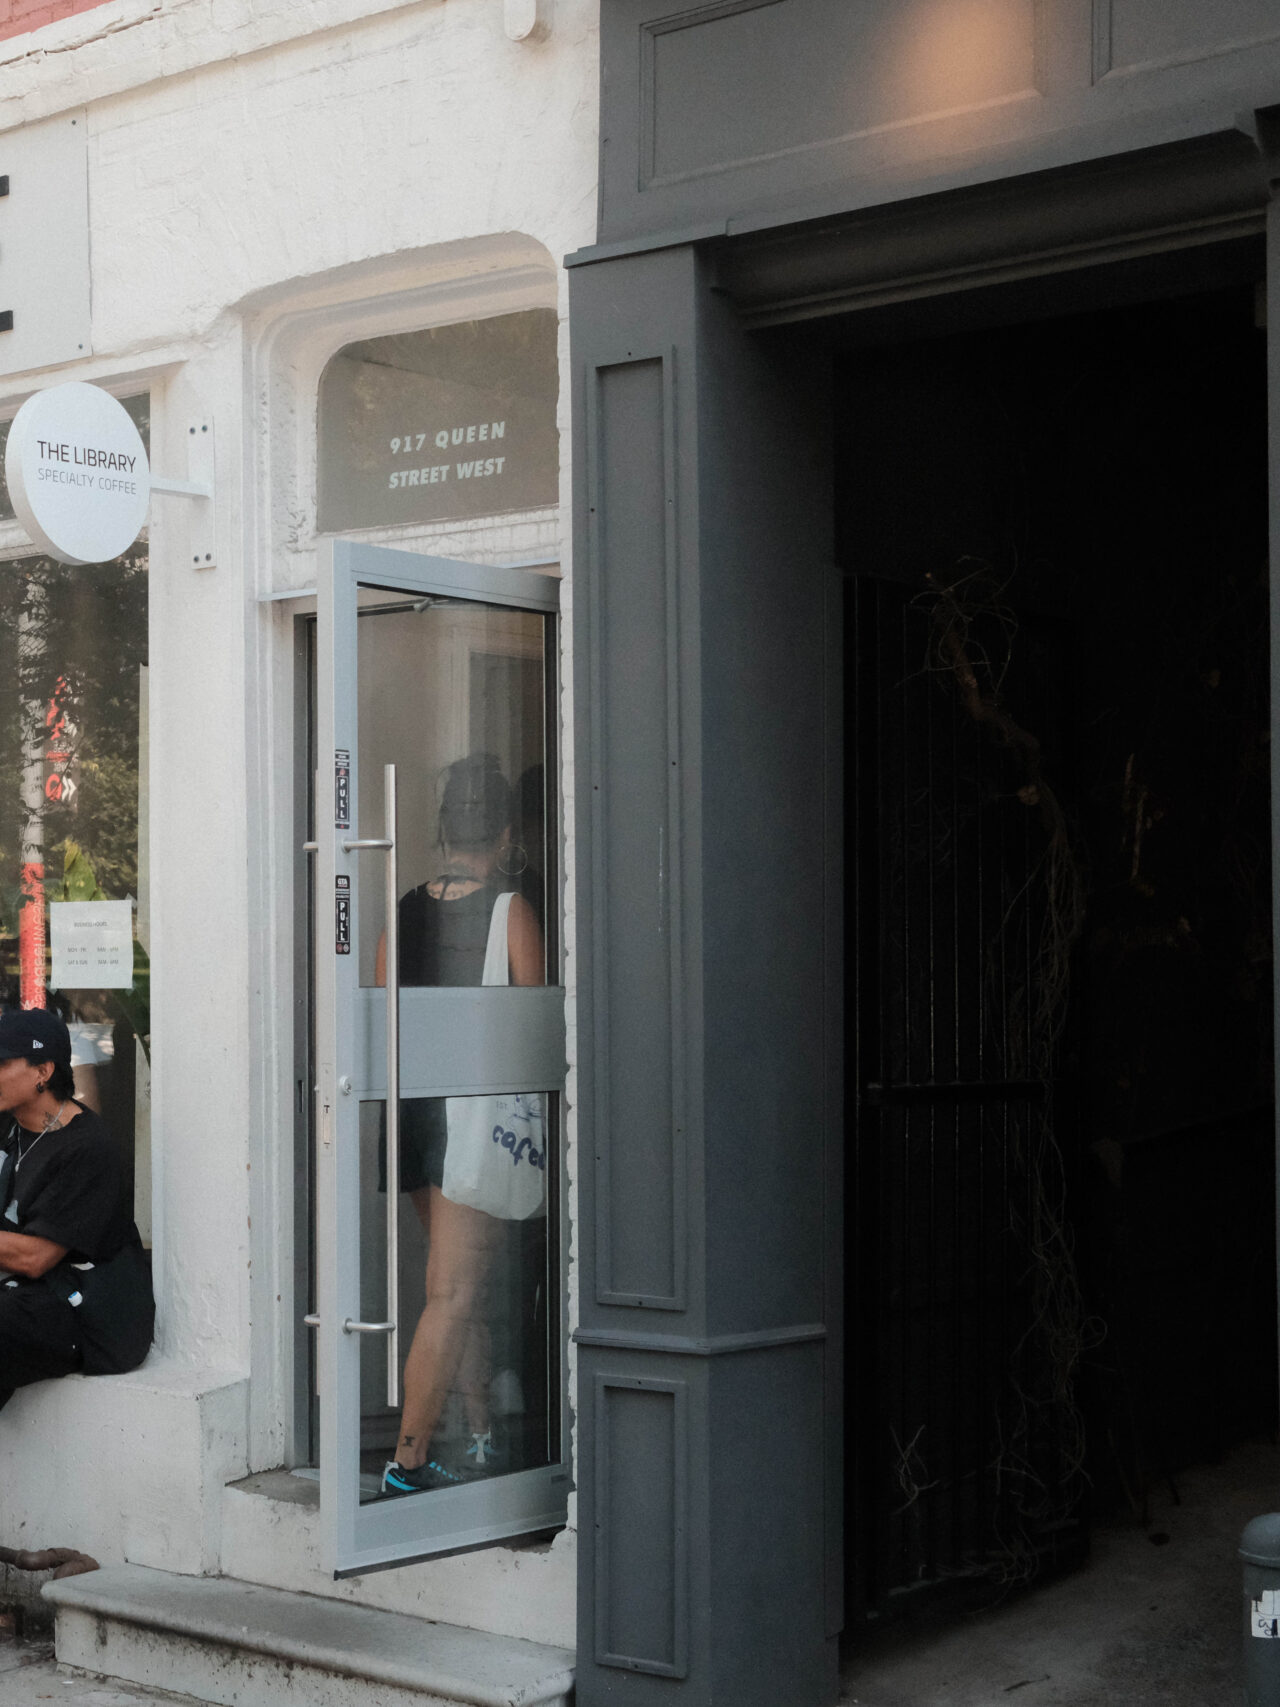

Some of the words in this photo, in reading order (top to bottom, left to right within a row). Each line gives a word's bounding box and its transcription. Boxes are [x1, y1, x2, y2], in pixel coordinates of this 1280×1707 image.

[389, 433, 426, 455] 917
[434, 421, 506, 450] QUEEN
[37, 440, 70, 463] THE
[74, 446, 137, 474] LIBRARY
[388, 464, 450, 489] STREET
[456, 457, 506, 480] WEST
[37, 467, 95, 488] SPECIALTY
[98, 477, 137, 495] COFFEE
